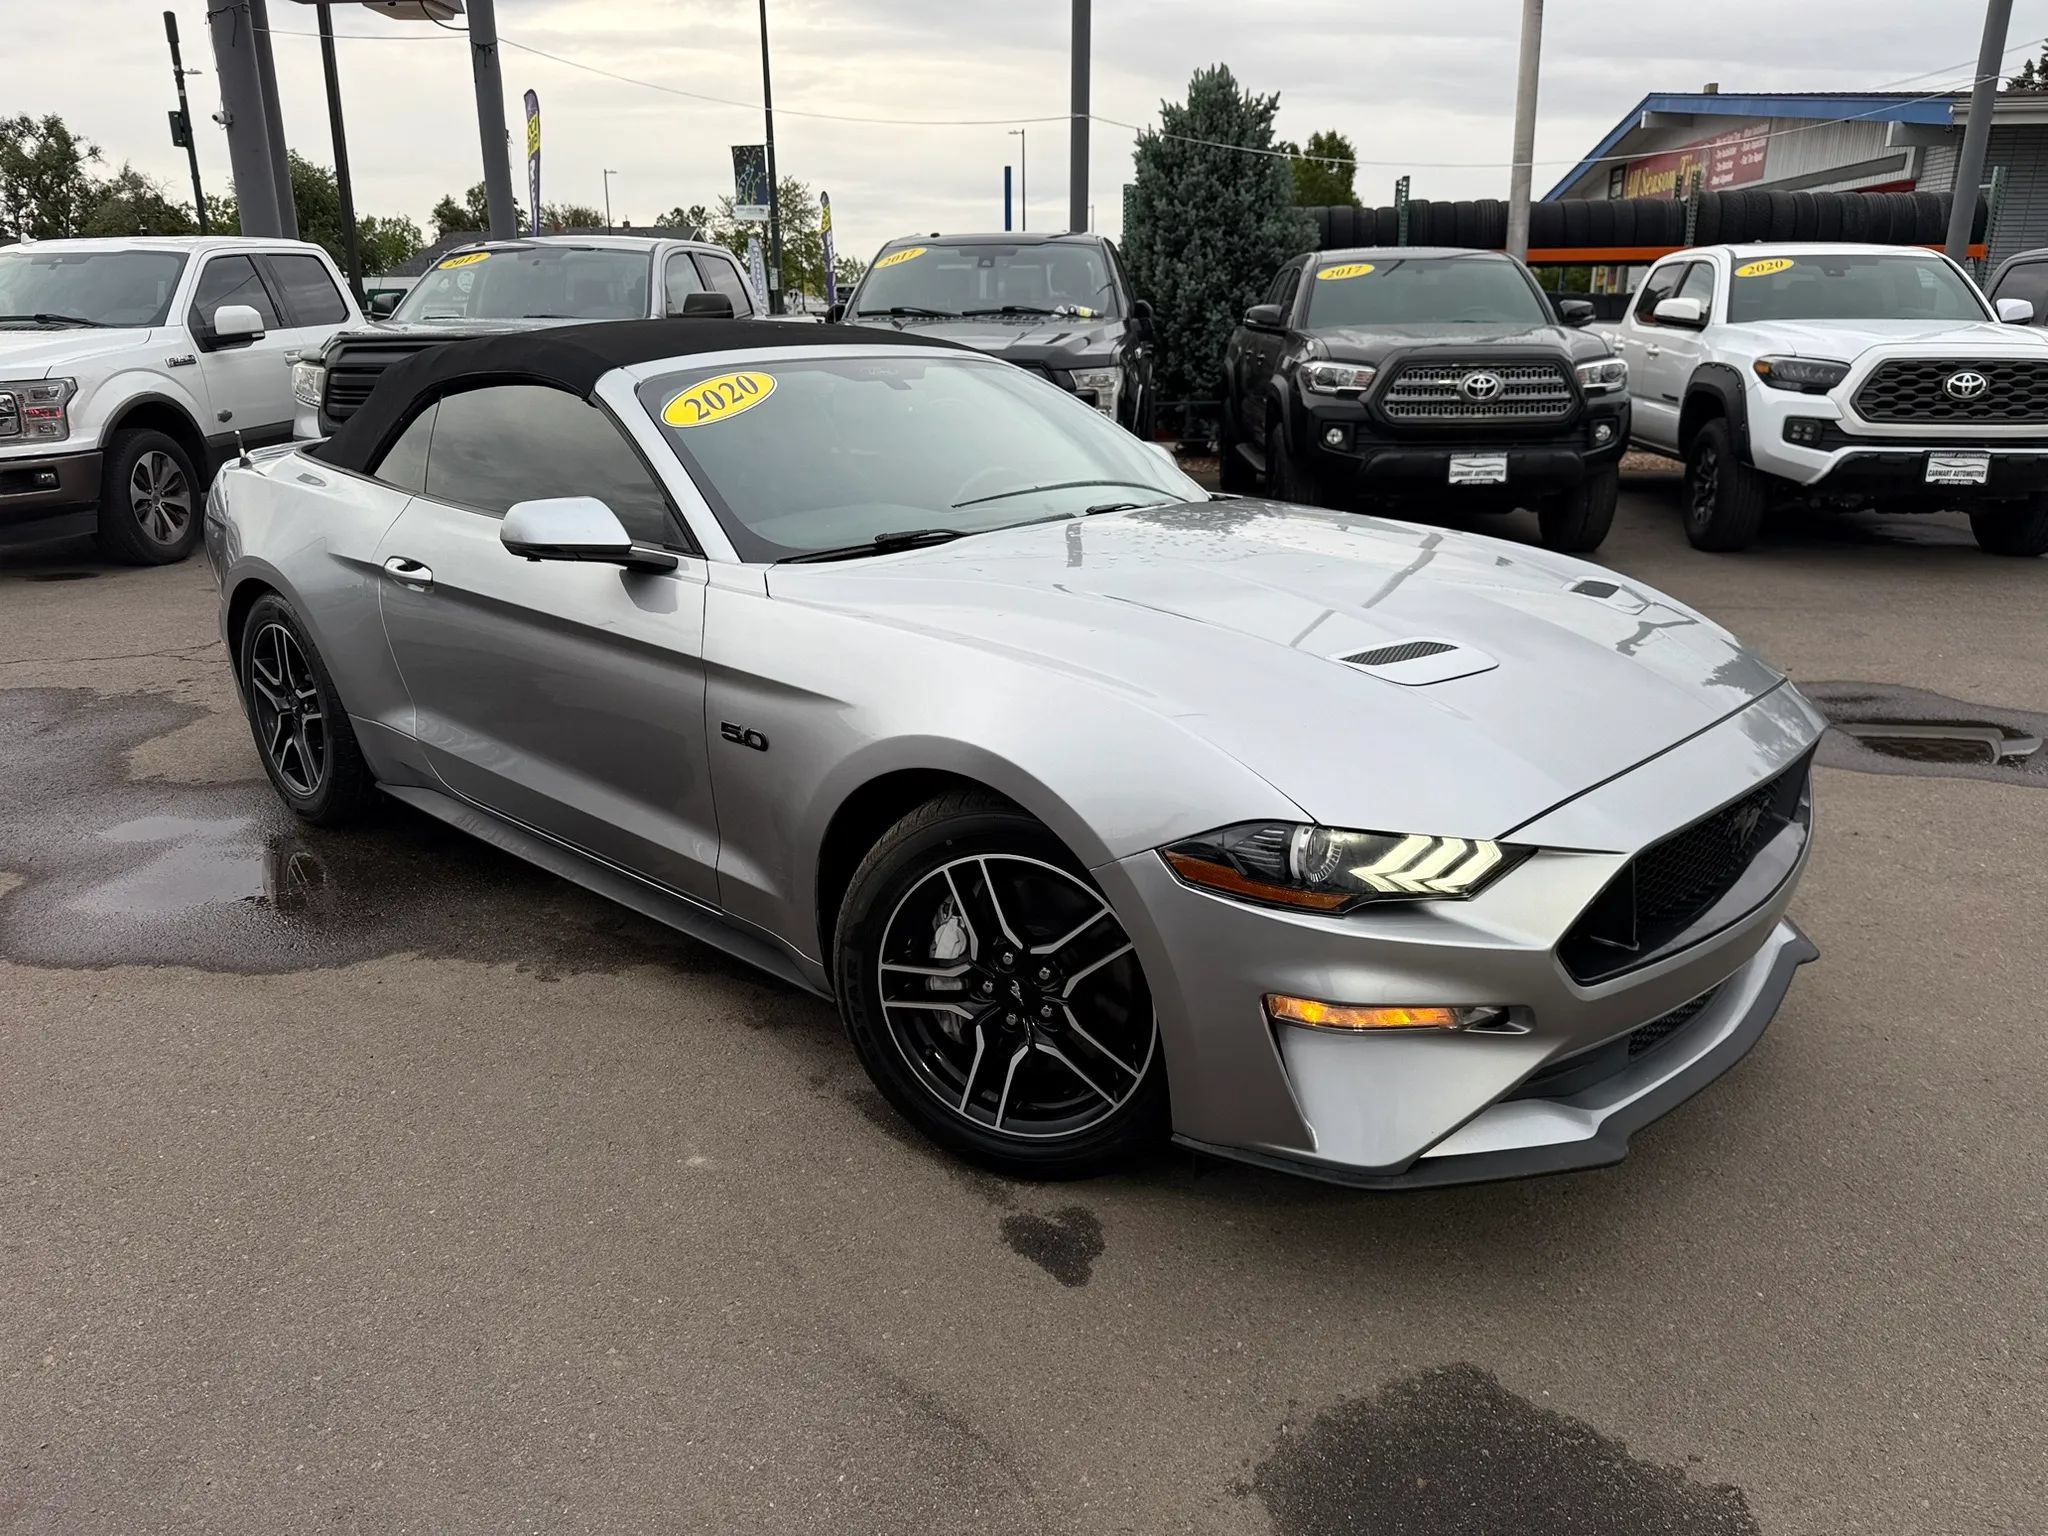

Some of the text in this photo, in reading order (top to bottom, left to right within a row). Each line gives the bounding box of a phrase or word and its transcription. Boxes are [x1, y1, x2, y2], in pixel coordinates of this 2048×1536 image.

[445, 254, 482, 268] 2017
[883, 249, 918, 266] 2017
[1327, 266, 1363, 278] 2017
[1748, 260, 1783, 275] 2020
[684, 376, 759, 420] 2020
